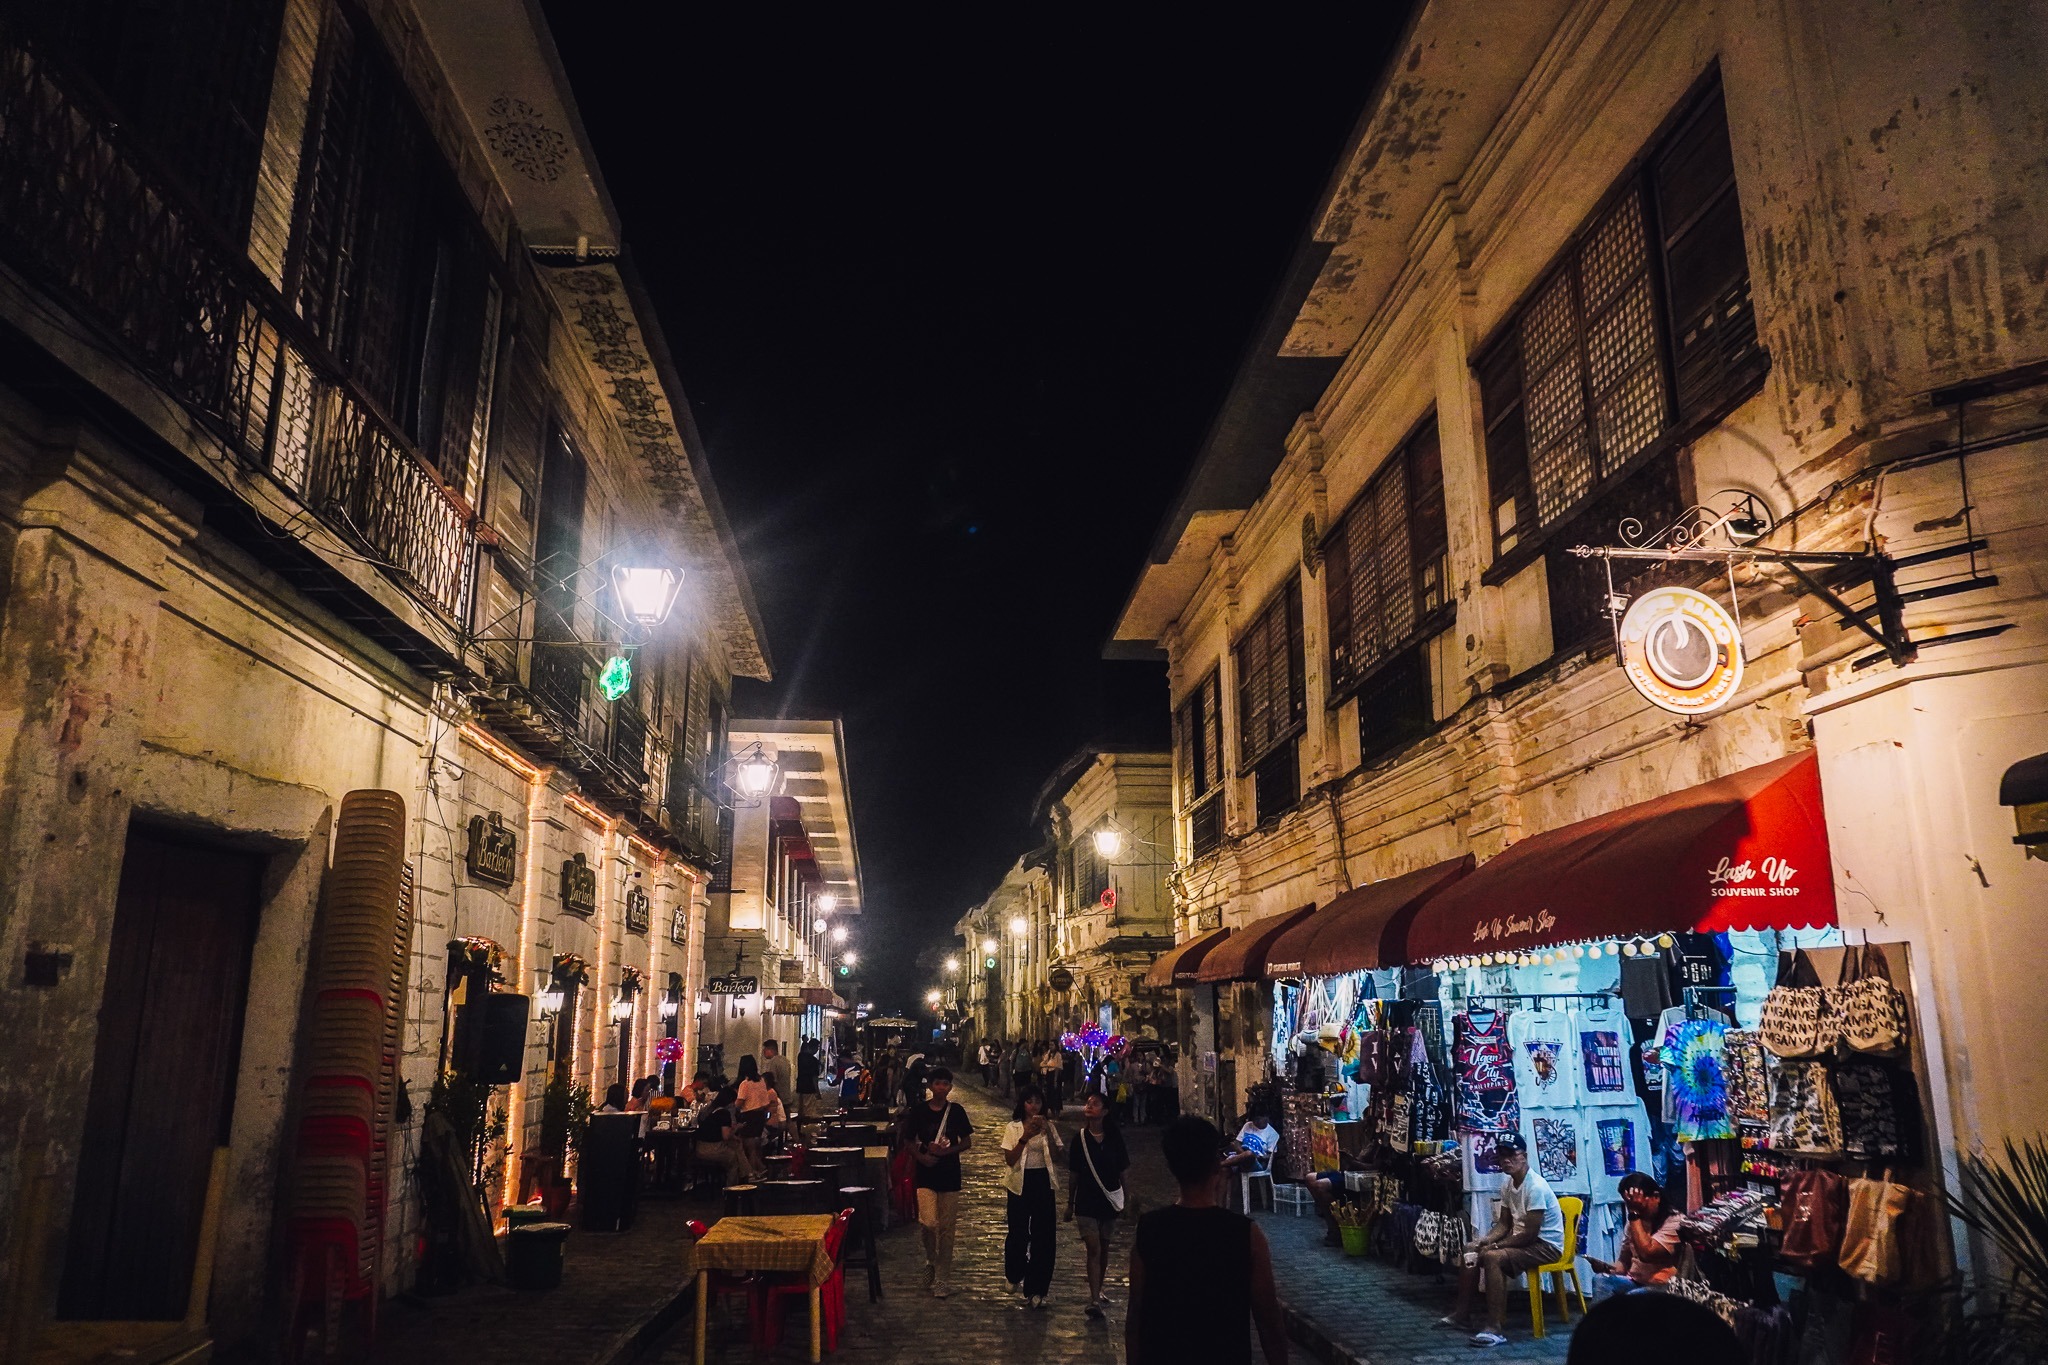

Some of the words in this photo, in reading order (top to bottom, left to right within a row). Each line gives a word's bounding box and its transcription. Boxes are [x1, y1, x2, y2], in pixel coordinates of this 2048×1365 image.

[479, 836, 513, 876] BarTech
[1707, 856, 1757, 884] Lash
[1761, 856, 1798, 887] Up
[1711, 887, 1767, 897] SOUVENIR
[1769, 887, 1800, 897] SHOP
[711, 979, 754, 994] BarTech
[1464, 1045, 1499, 1066] Vigan
[1474, 1063, 1504, 1082] City
[1592, 1066, 1622, 1086] VIGAN
